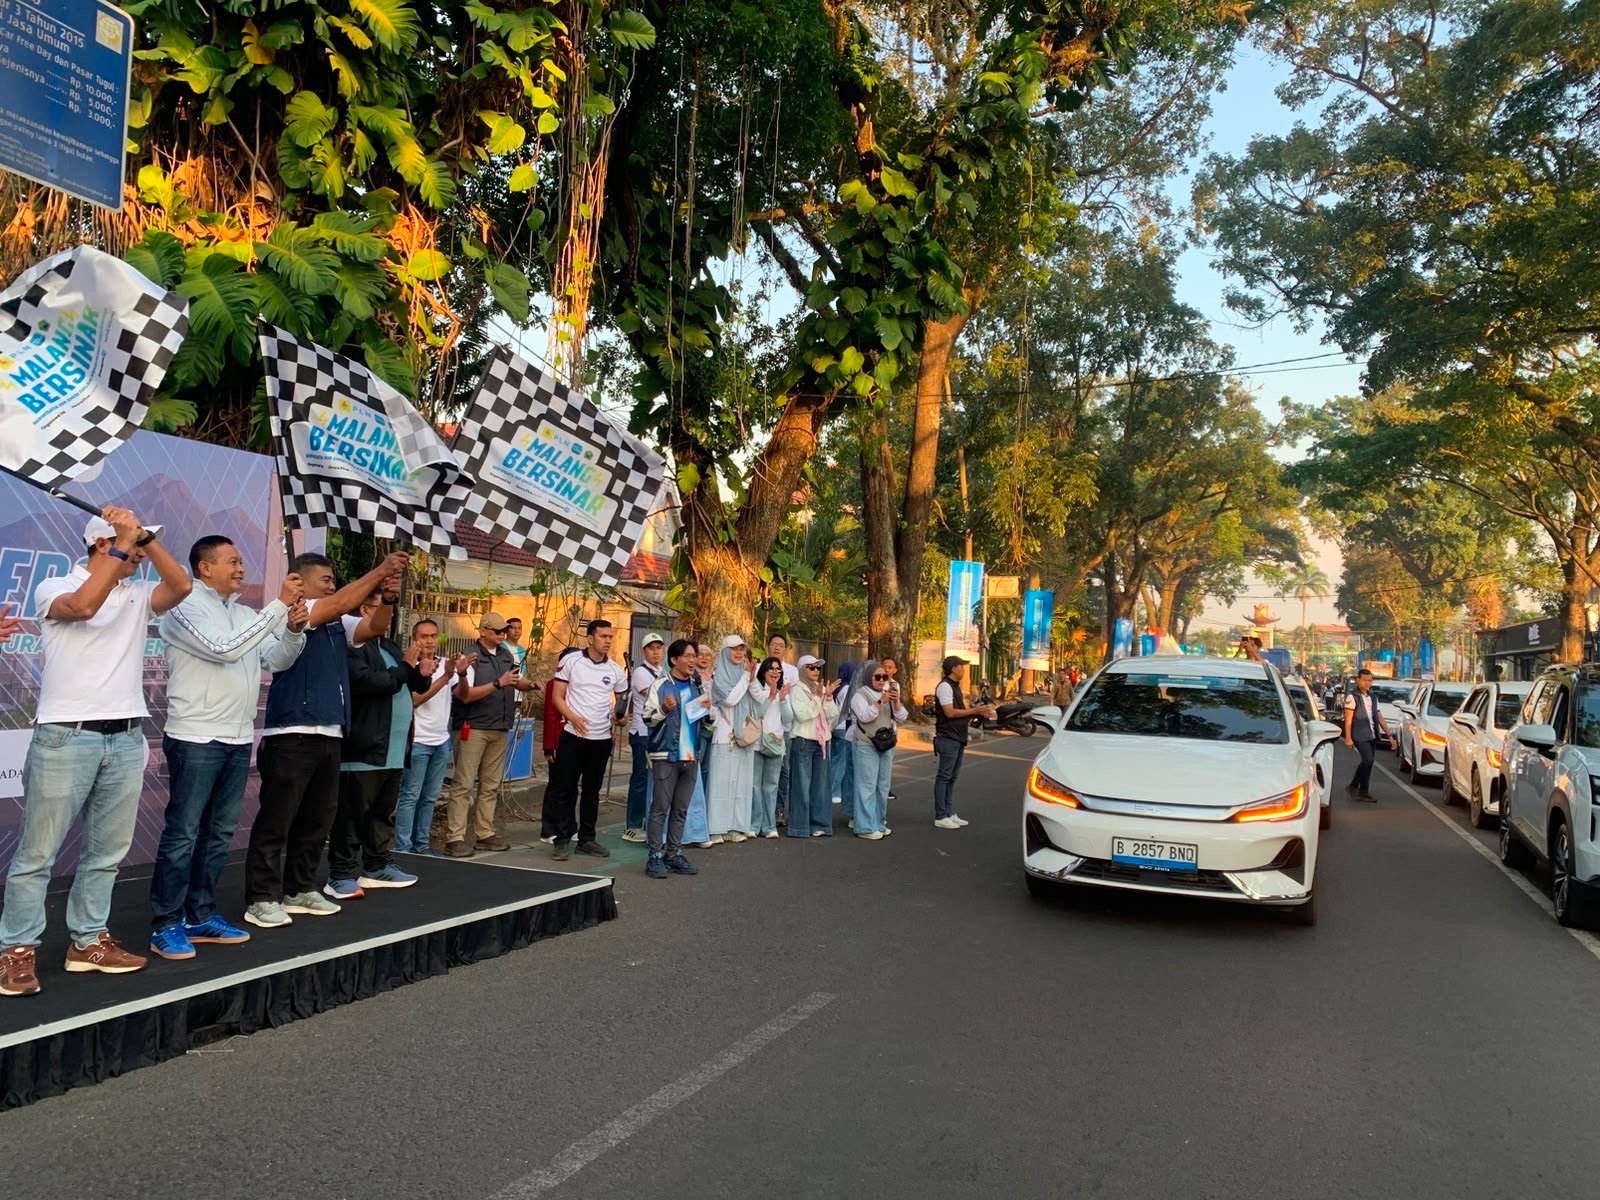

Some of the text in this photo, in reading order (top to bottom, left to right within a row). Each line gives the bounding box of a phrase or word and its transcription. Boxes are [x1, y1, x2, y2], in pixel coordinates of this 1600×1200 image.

[7, 14, 33, 34] Jasa
[37, 28, 70, 54] Umum
[15, 4, 21, 16] 3
[26, 9, 56, 34] Tahun
[60, 28, 85, 49] 2015
[17, 35, 35, 51] Free
[37, 45, 52, 61] Day
[54, 55, 69, 69] dan
[71, 62, 93, 80] Pasar
[69, 89, 82, 102] Rp.
[70, 76, 83, 90] Rp.
[68, 100, 82, 114] Rp.
[9, 317, 75, 388] MALANG
[16, 304, 99, 414] BERSINAR
[502, 448, 606, 516] BERSINAR
[527, 438, 597, 484] MALANG
[1117, 841, 1194, 861] B 2857 BNQ
